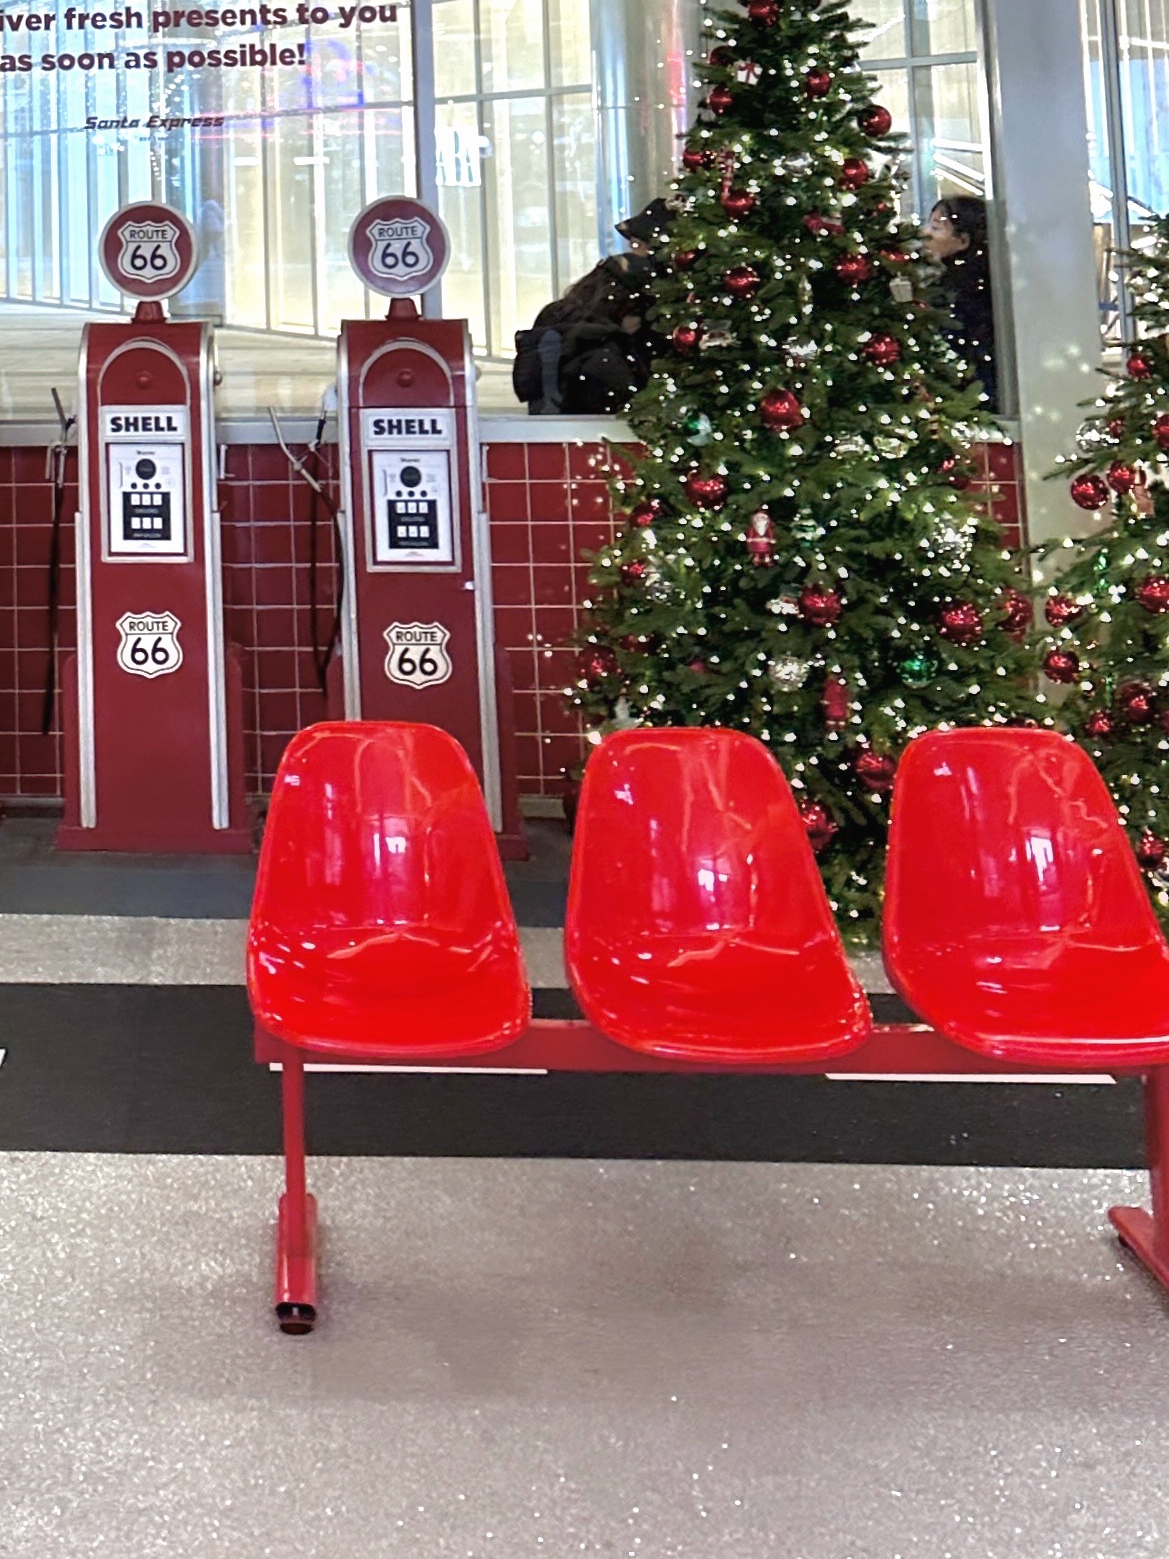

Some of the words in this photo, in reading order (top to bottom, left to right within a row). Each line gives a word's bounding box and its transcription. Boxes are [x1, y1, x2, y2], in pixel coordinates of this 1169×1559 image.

[64, 4, 143, 30] fresh
[152, 6, 288, 34] presents
[296, 2, 329, 25] to
[337, 4, 398, 30] you
[0, 53, 31, 73] as
[40, 50, 115, 72] soon
[124, 49, 158, 70] as
[166, 42, 306, 74] possible!
[83, 116, 141, 130] Santa
[146, 115, 225, 132] Express
[128, 227, 168, 242] ROUTE
[376, 224, 419, 240] ROUTE
[130, 244, 168, 271] 66
[380, 242, 420, 270] 66
[110, 416, 178, 433] SHELL
[373, 418, 443, 436] SHELL
[128, 620, 170, 634] ROUTE
[395, 629, 439, 643] ROUTE
[130, 636, 170, 666] 66
[397, 645, 439, 676] 66
